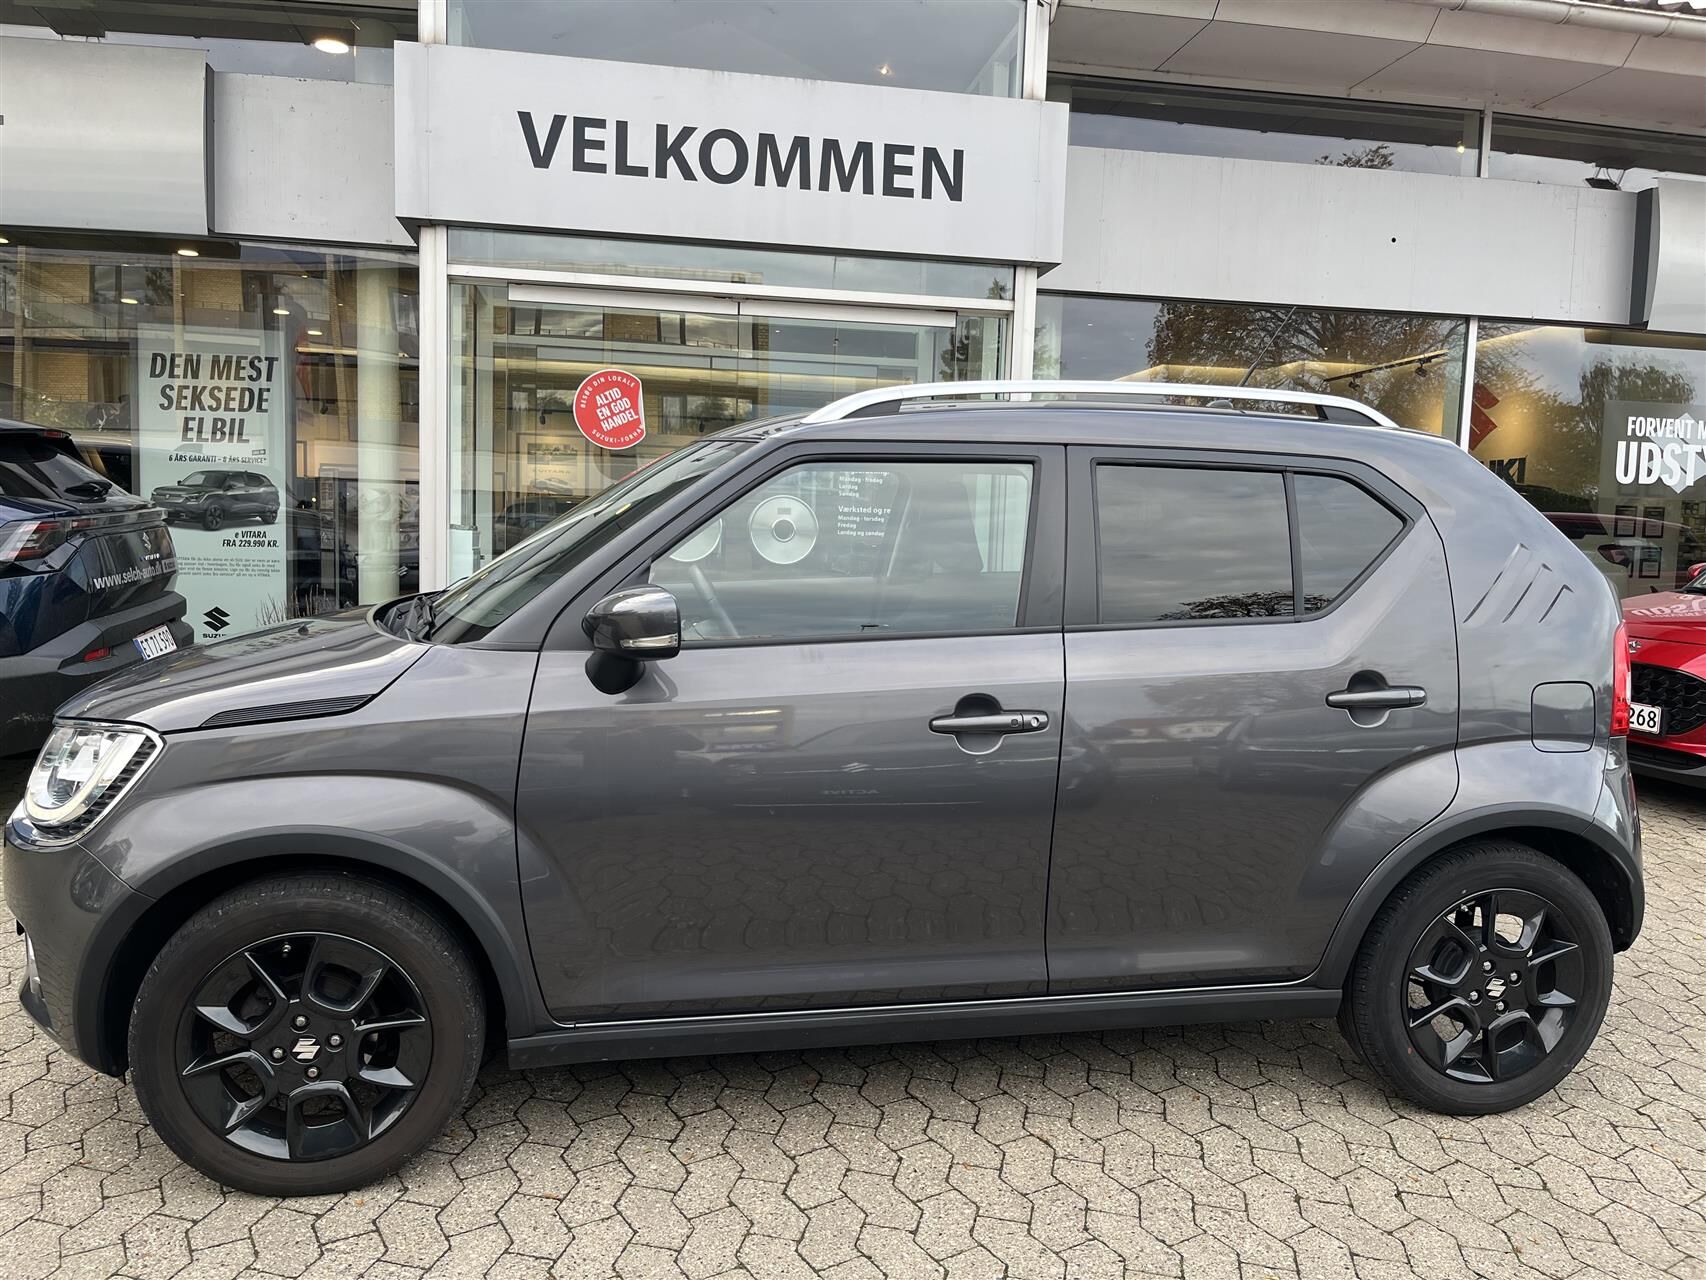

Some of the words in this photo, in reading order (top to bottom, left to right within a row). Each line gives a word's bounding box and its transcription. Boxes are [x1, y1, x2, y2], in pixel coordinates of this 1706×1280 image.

[517, 110, 965, 203] VELKOMMEN
[149, 352, 202, 379] DEN
[209, 354, 279, 382] MEST
[592, 377, 605, 387] DIN
[607, 375, 636, 388] LOKALE
[158, 383, 271, 413] SEKSEDE
[595, 387, 622, 407] ALTID
[595, 405, 611, 420] EN
[610, 397, 631, 414] GOD
[181, 416, 250, 444] ELBIL
[600, 408, 639, 432] HANDEL
[1627, 416, 1695, 439] FORVENT
[188, 455, 217, 463] GARANTI
[838, 505, 872, 513] Værksted
[222, 539, 237, 547] FRA
[238, 539, 266, 548] 229.990
[267, 539, 280, 548] KR.
[241, 530, 267, 539] VITARA
